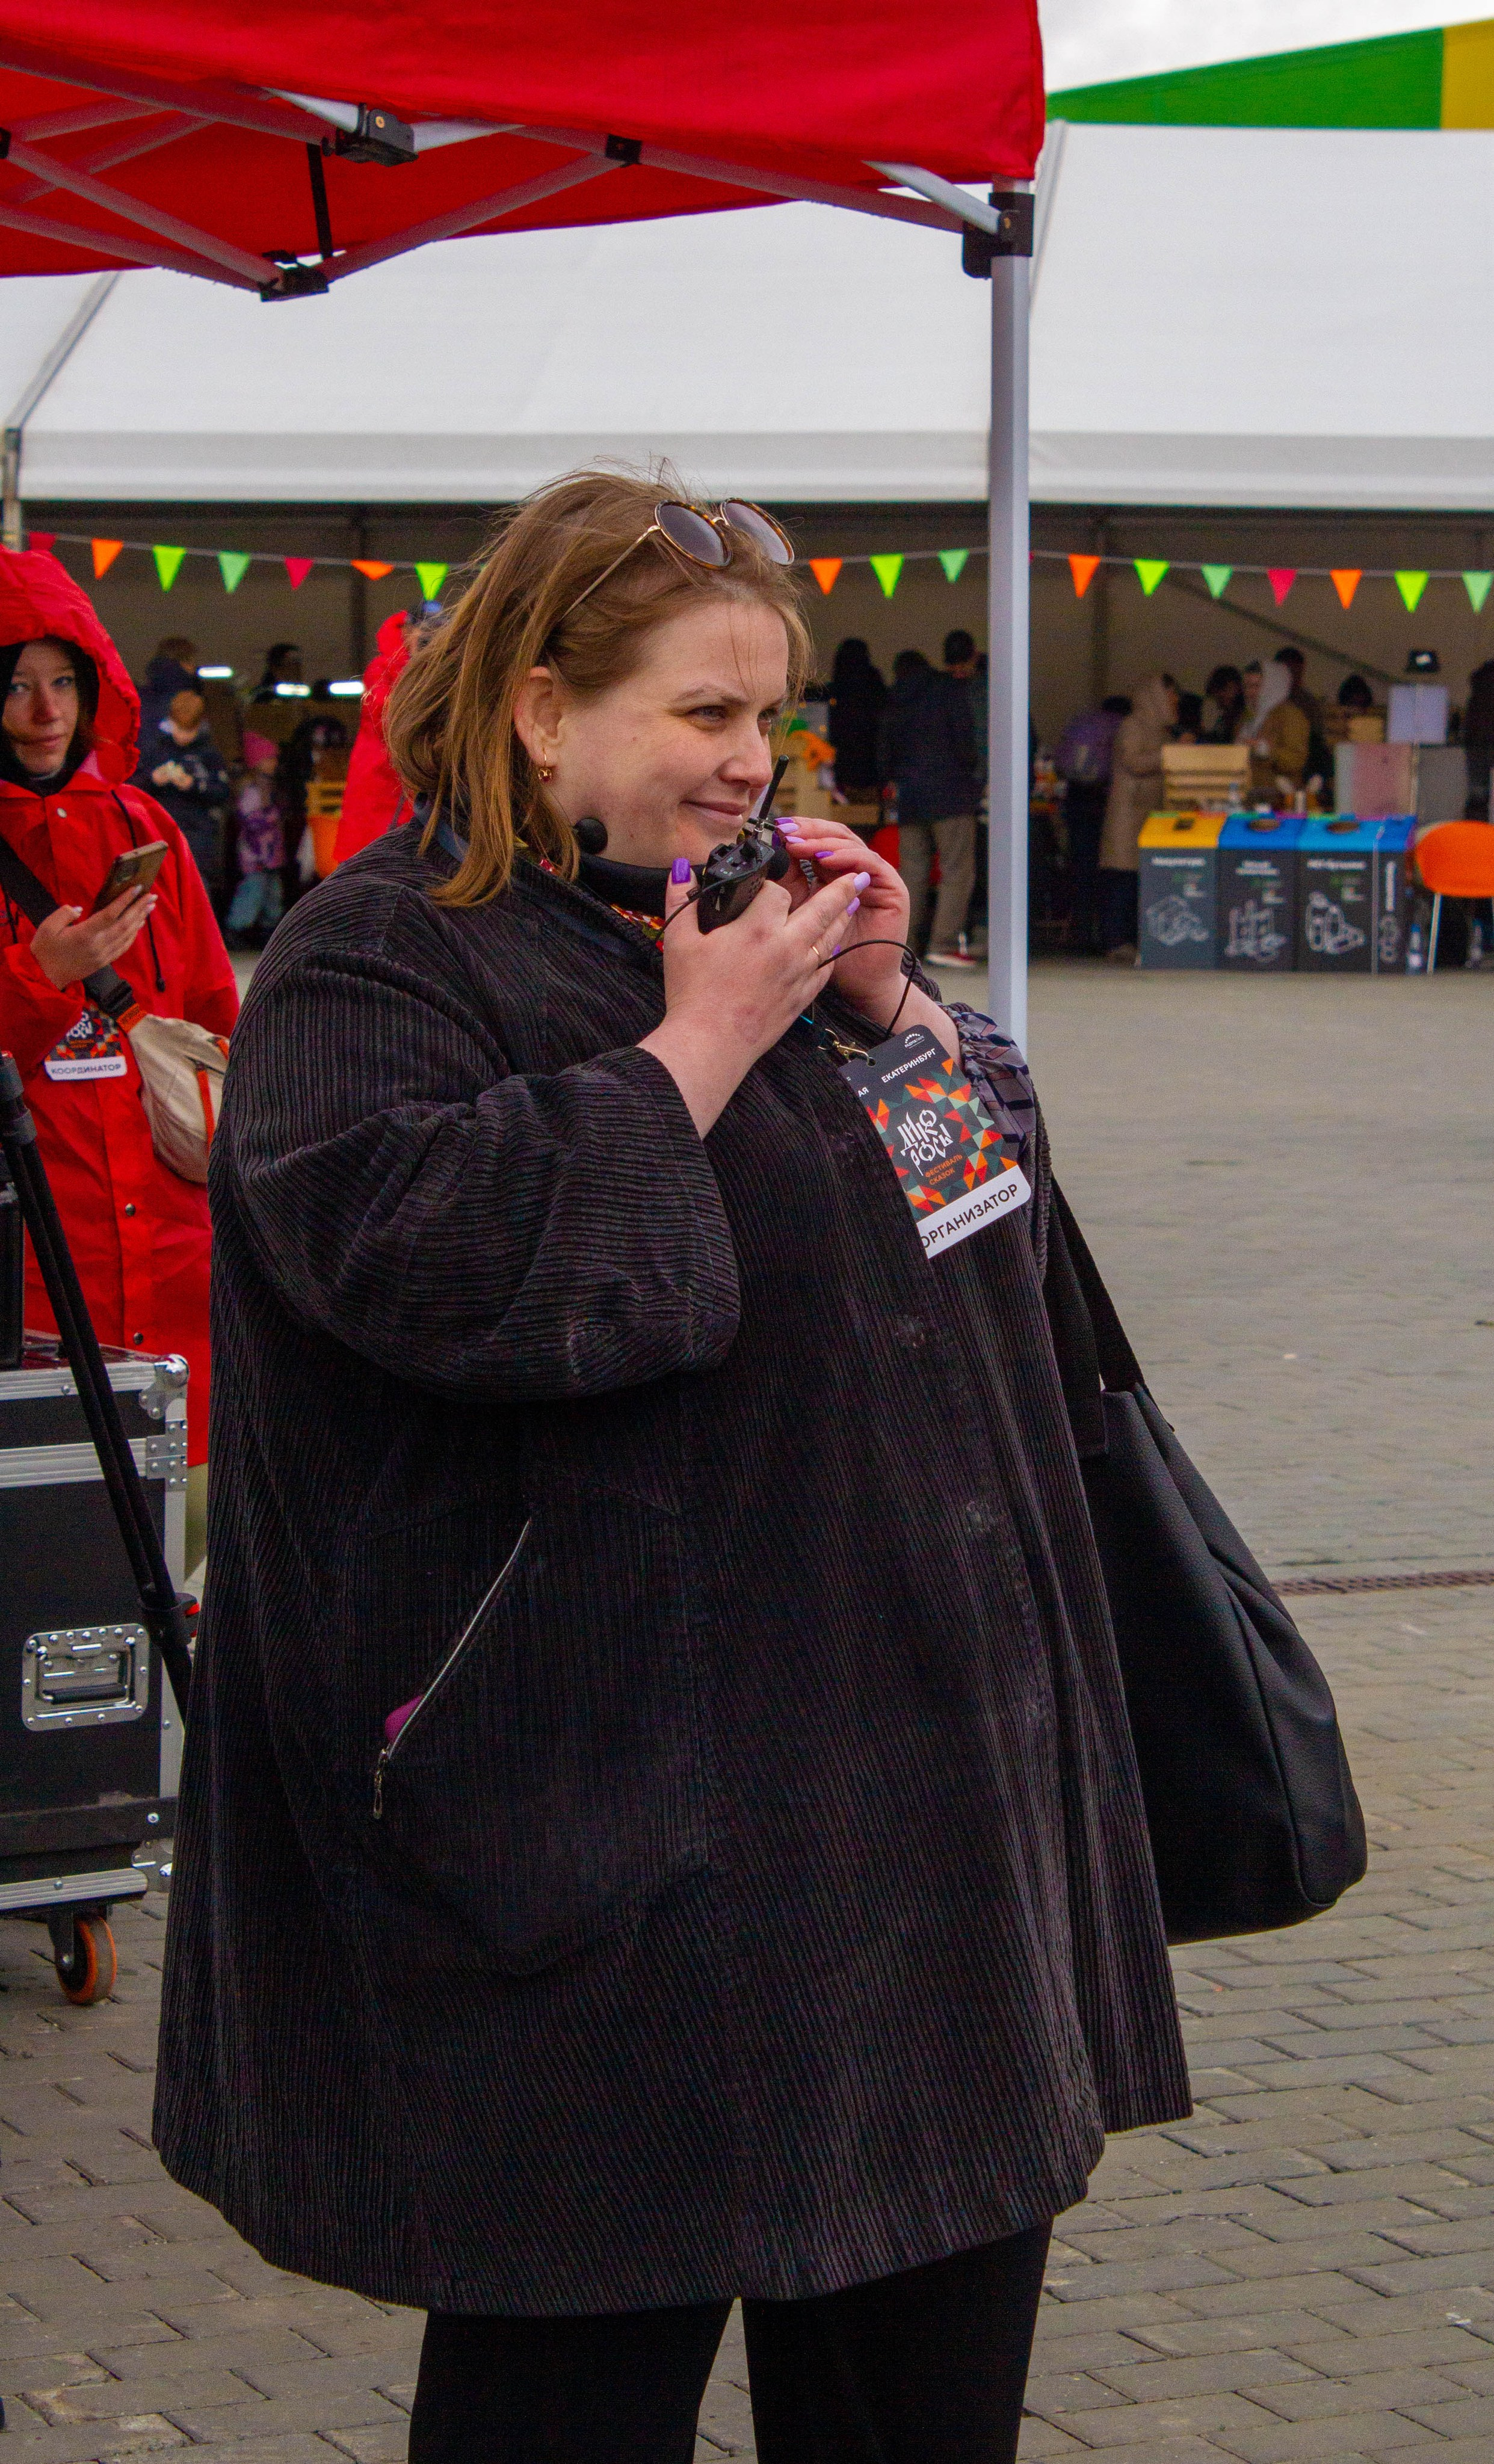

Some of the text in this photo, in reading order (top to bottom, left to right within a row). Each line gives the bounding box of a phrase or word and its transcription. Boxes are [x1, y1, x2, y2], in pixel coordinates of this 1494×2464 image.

[51, 1062, 121, 1074] КООРДИНАТОР
[881, 1048, 936, 1083] ЕКАТЕРИНБУРГ
[925, 1154, 963, 1178] ФЕСТИВАЛЬ
[929, 1168, 955, 1185] СКАЗОК
[921, 1184, 1017, 1249] ОРГАНИЗАТОР
